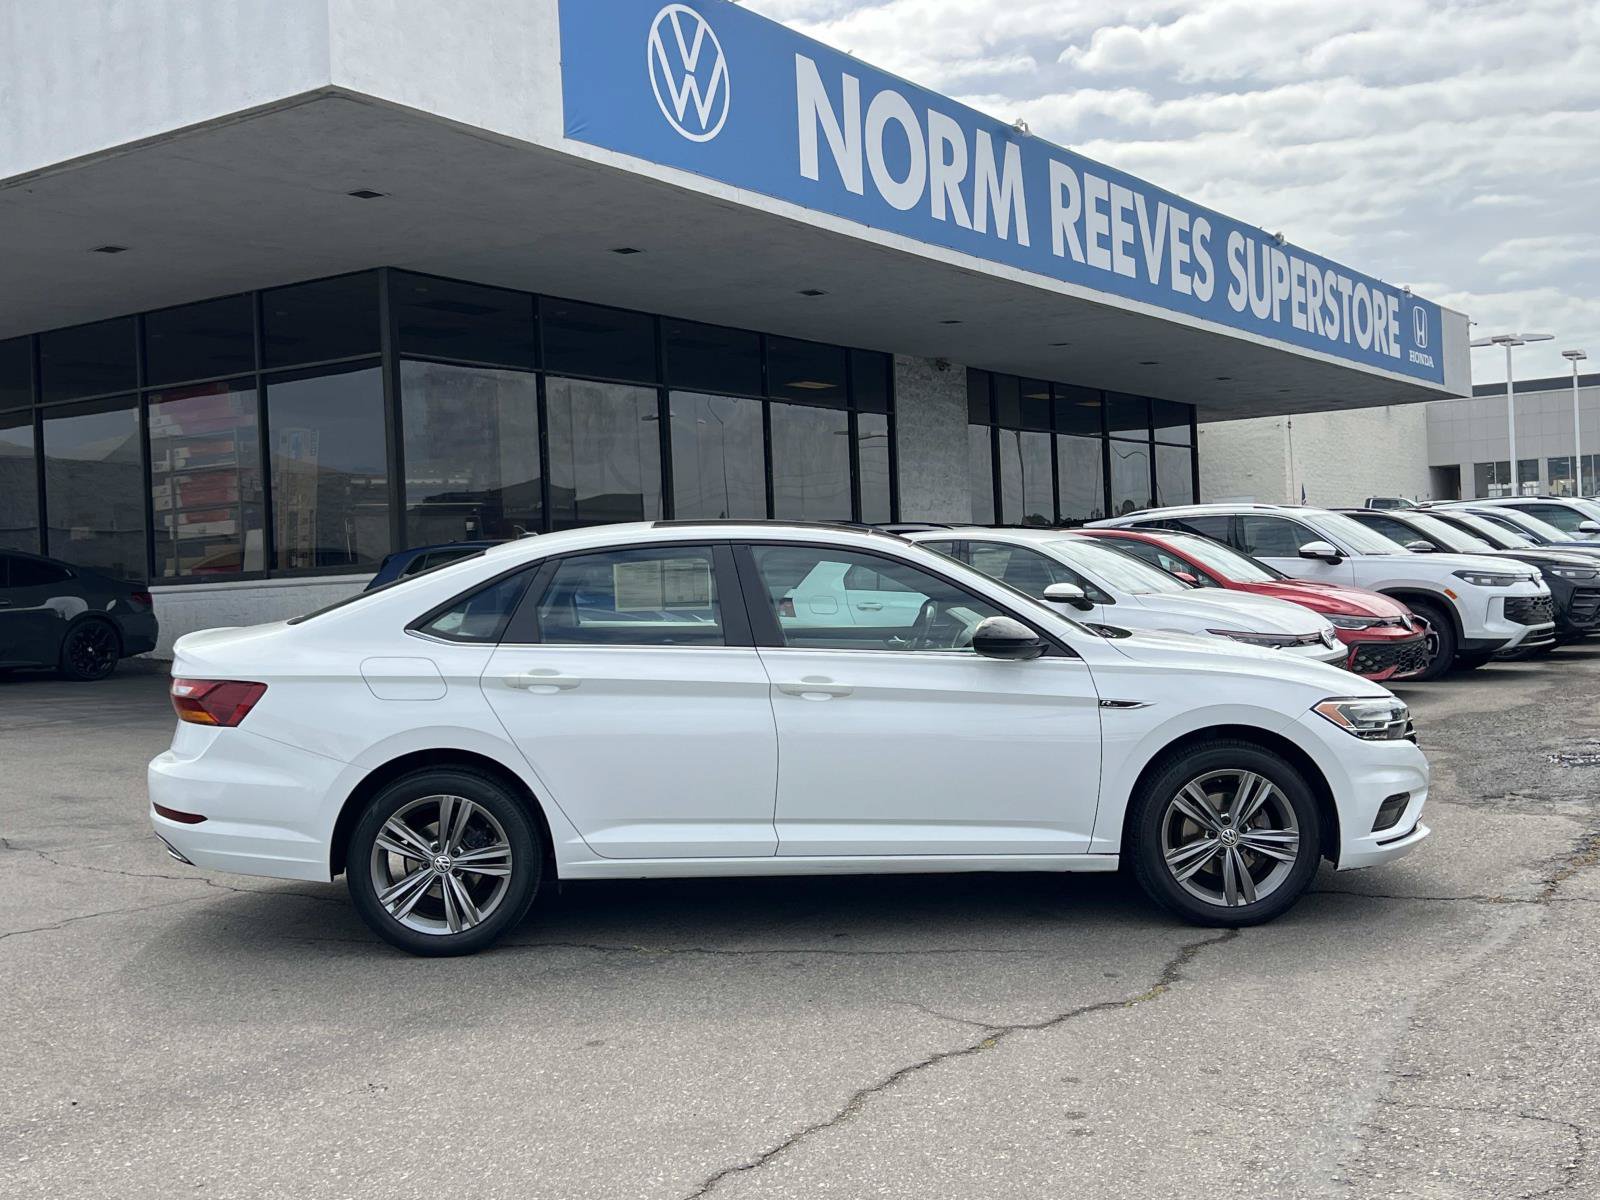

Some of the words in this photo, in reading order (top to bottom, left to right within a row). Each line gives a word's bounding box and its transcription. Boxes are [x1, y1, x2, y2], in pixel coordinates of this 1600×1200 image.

[795, 53, 1030, 247] NORM
[1049, 158, 1215, 302] REEVES
[1227, 230, 1401, 359] SUPERSTORE
[1409, 350, 1434, 368] HONDA
